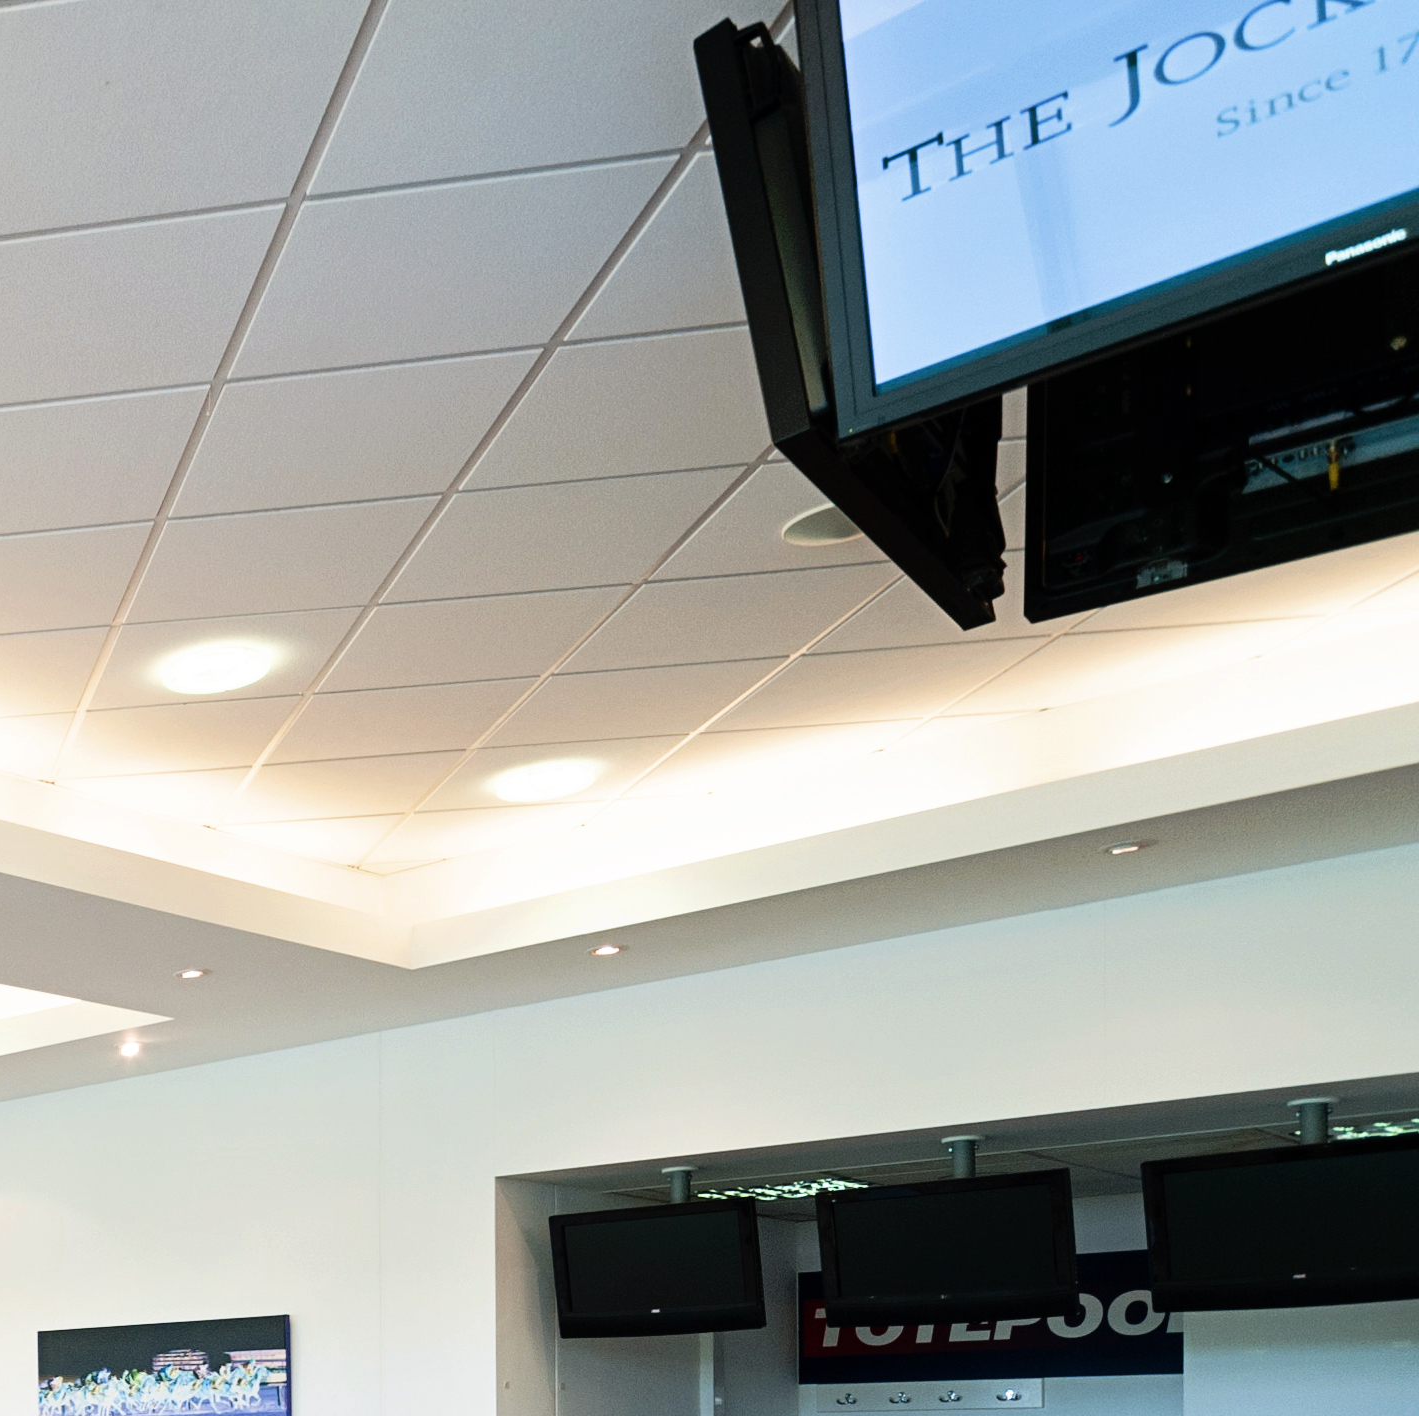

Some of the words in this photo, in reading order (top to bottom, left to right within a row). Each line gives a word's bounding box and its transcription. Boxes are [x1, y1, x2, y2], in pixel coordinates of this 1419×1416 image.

[1216, 69, 1351, 138] Since
[881, 90, 1073, 203] THE
[1324, 228, 1407, 266] Panasonic
[814, 1290, 1184, 1347] TOEPOO
